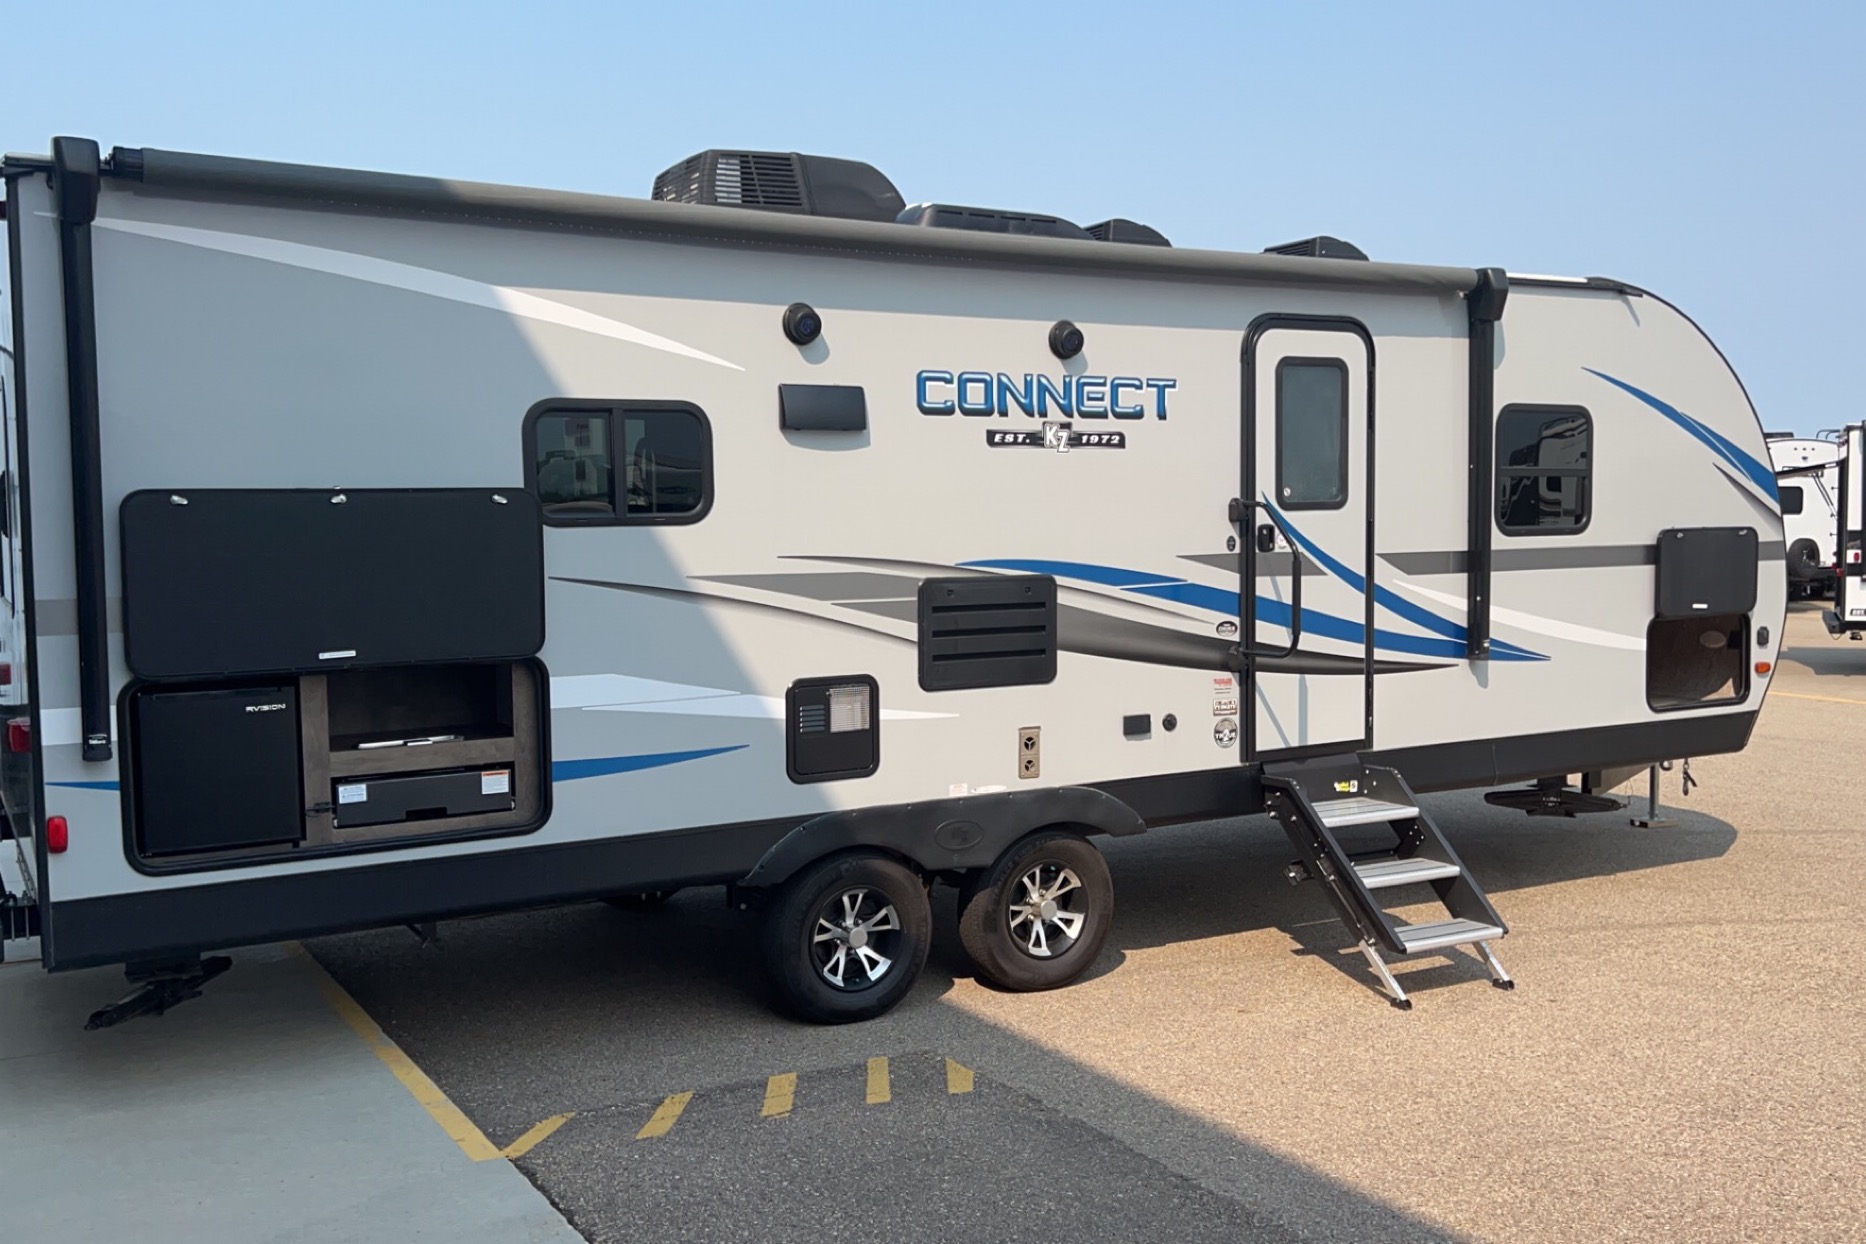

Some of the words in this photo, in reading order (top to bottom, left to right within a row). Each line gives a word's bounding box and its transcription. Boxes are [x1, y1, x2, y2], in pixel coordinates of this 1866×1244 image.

[916, 370, 1177, 420] CONNECT
[993, 433, 1031, 443] EST.
[1080, 433, 1121, 445] 1972
[245, 704, 286, 713] RVISION
